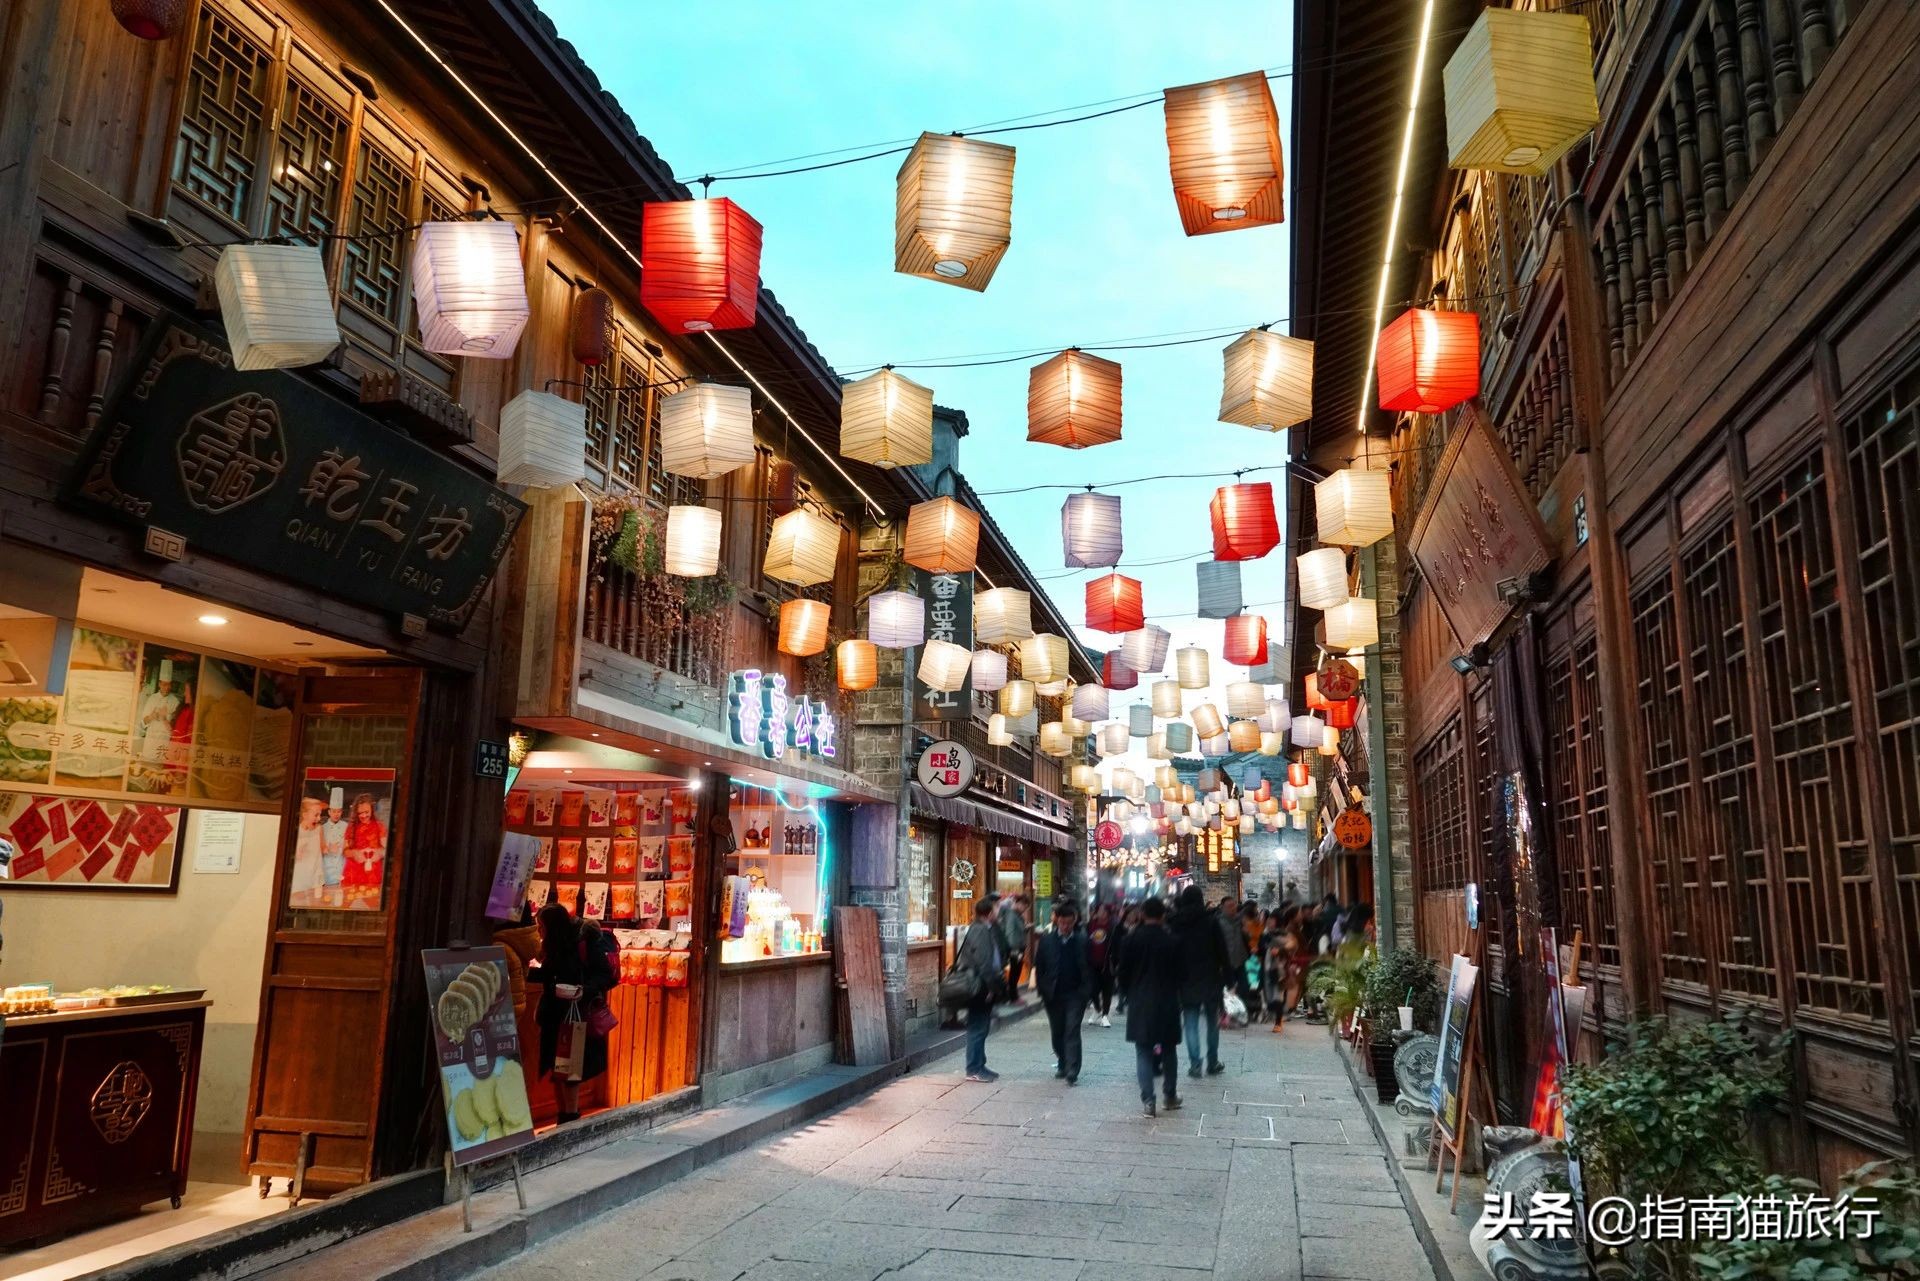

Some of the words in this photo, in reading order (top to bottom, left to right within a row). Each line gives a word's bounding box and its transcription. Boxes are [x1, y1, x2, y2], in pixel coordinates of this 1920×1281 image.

[299, 447, 473, 560] 乾玉坊
[286, 518, 337, 549] QIAN
[359, 550, 383, 571] YU
[400, 566, 443, 595] FANG
[733, 669, 835, 759] 番薯公社
[482, 757, 503, 775] 255
